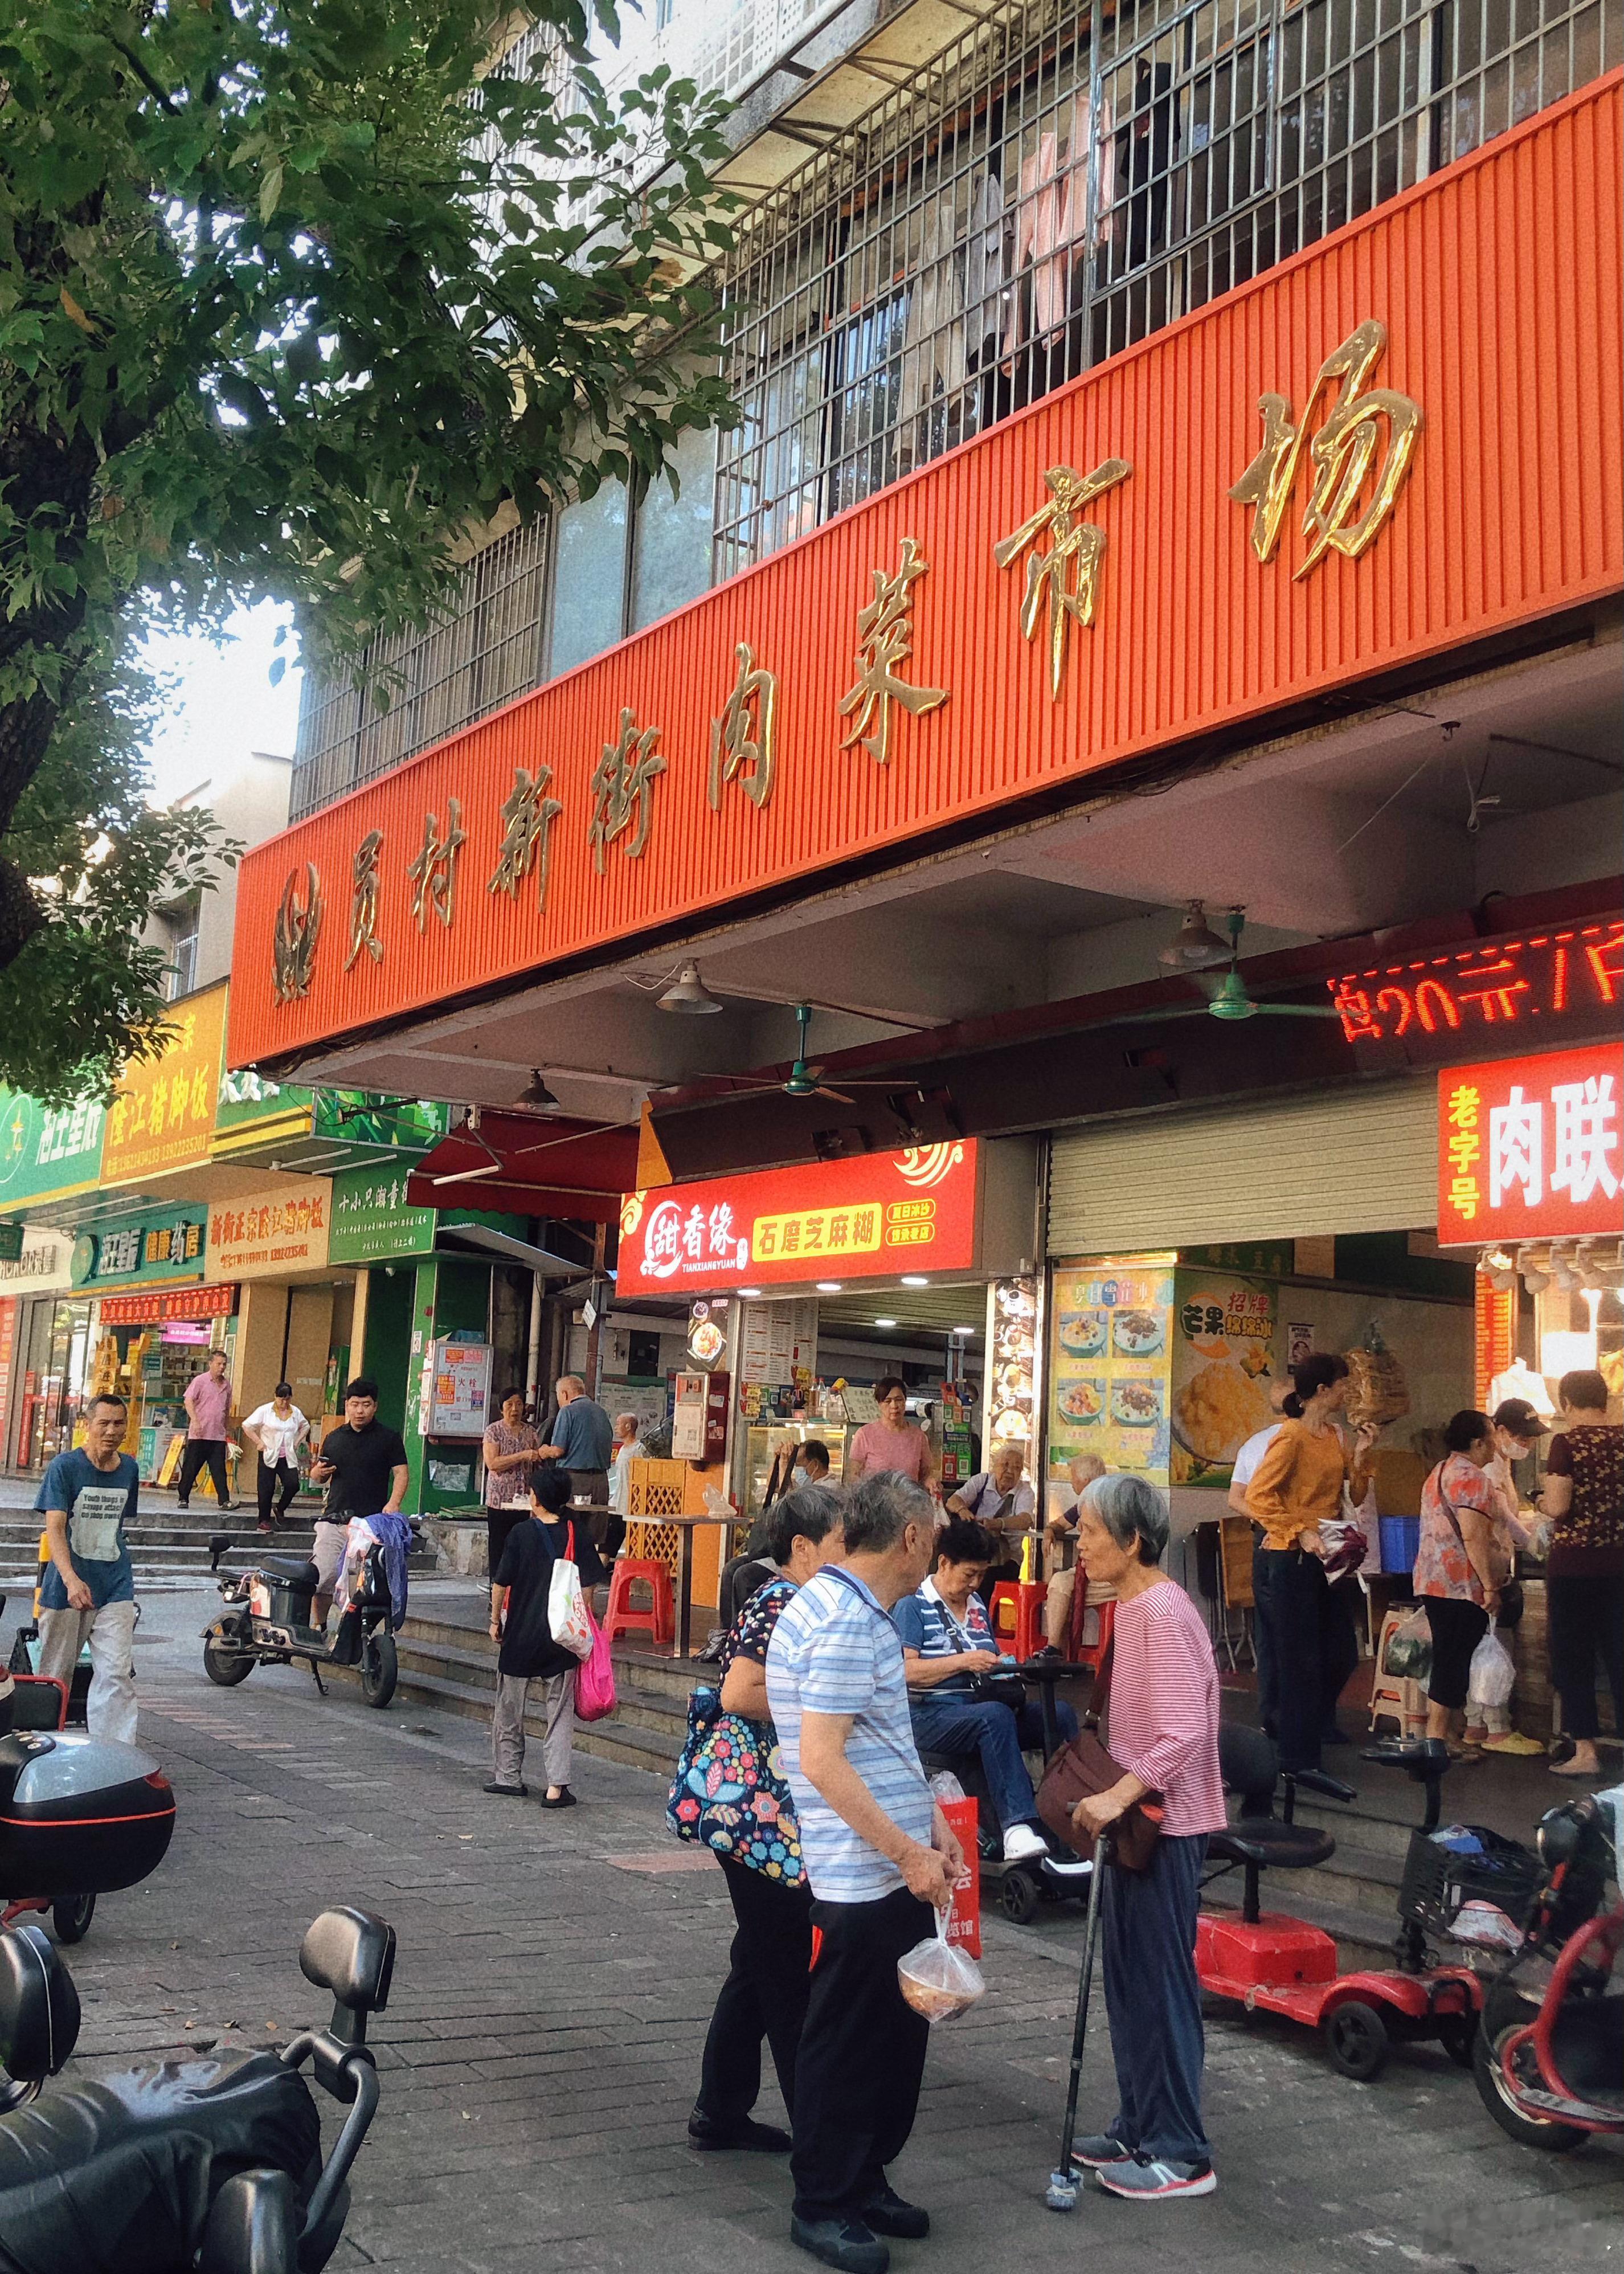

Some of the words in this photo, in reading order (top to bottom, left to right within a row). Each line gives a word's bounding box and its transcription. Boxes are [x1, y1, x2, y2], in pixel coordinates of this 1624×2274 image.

[1447, 1085, 1480, 1220] 老字号
[1489, 1074, 1624, 1208] 肉联
[653, 1201, 737, 1260] 甜香缘
[759, 1210, 874, 1255] 石磨芝麻糊
[682, 1258, 736, 1273] TIANXIANGYUAN
[1183, 1304, 1225, 1335] 芒果
[1228, 1291, 1270, 1314] 招牌
[1226, 1314, 1274, 1340] 绵绵冰
